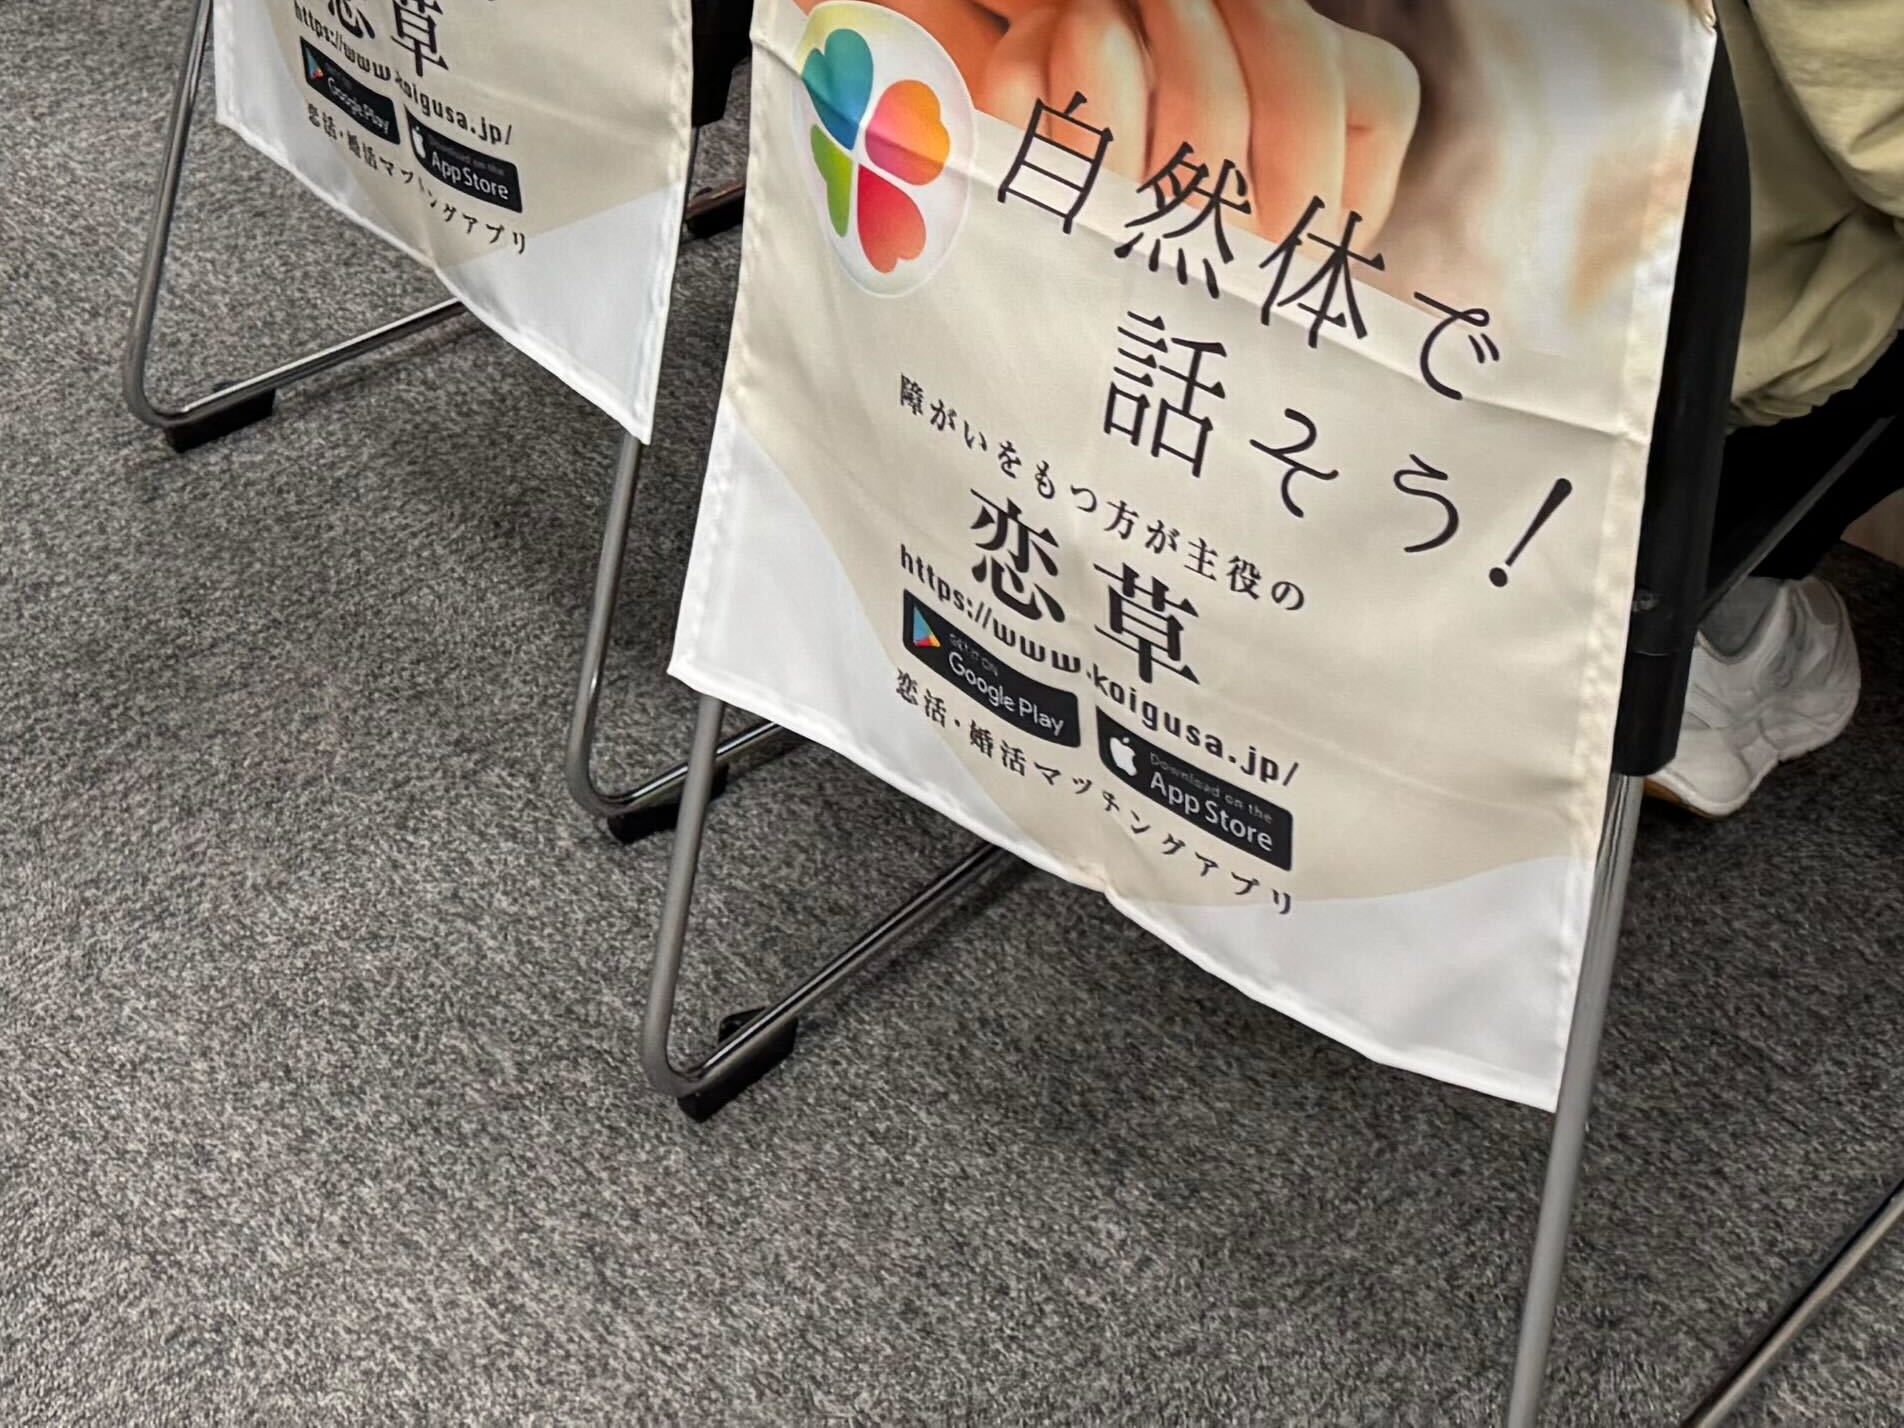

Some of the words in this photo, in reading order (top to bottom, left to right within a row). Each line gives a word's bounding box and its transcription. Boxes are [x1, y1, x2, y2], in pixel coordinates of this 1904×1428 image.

[431, 151, 462, 184] App
[464, 168, 509, 201] Store
[996, 89, 1501, 402] 自然体で
[898, 372, 1306, 613] 障がいをもつ方が主役の
[1102, 309, 1574, 588] 話そう！
[898, 542, 1300, 788] https://www.koigusa.jp/
[969, 486, 1201, 685] 恋草
[947, 649, 1018, 716] Google
[1018, 696, 1065, 737] Play
[1149, 752, 1221, 802] Download
[1226, 790, 1245, 812] on
[1247, 800, 1273, 826] the
[1149, 771, 1201, 817] App
[1203, 797, 1274, 851] Store
